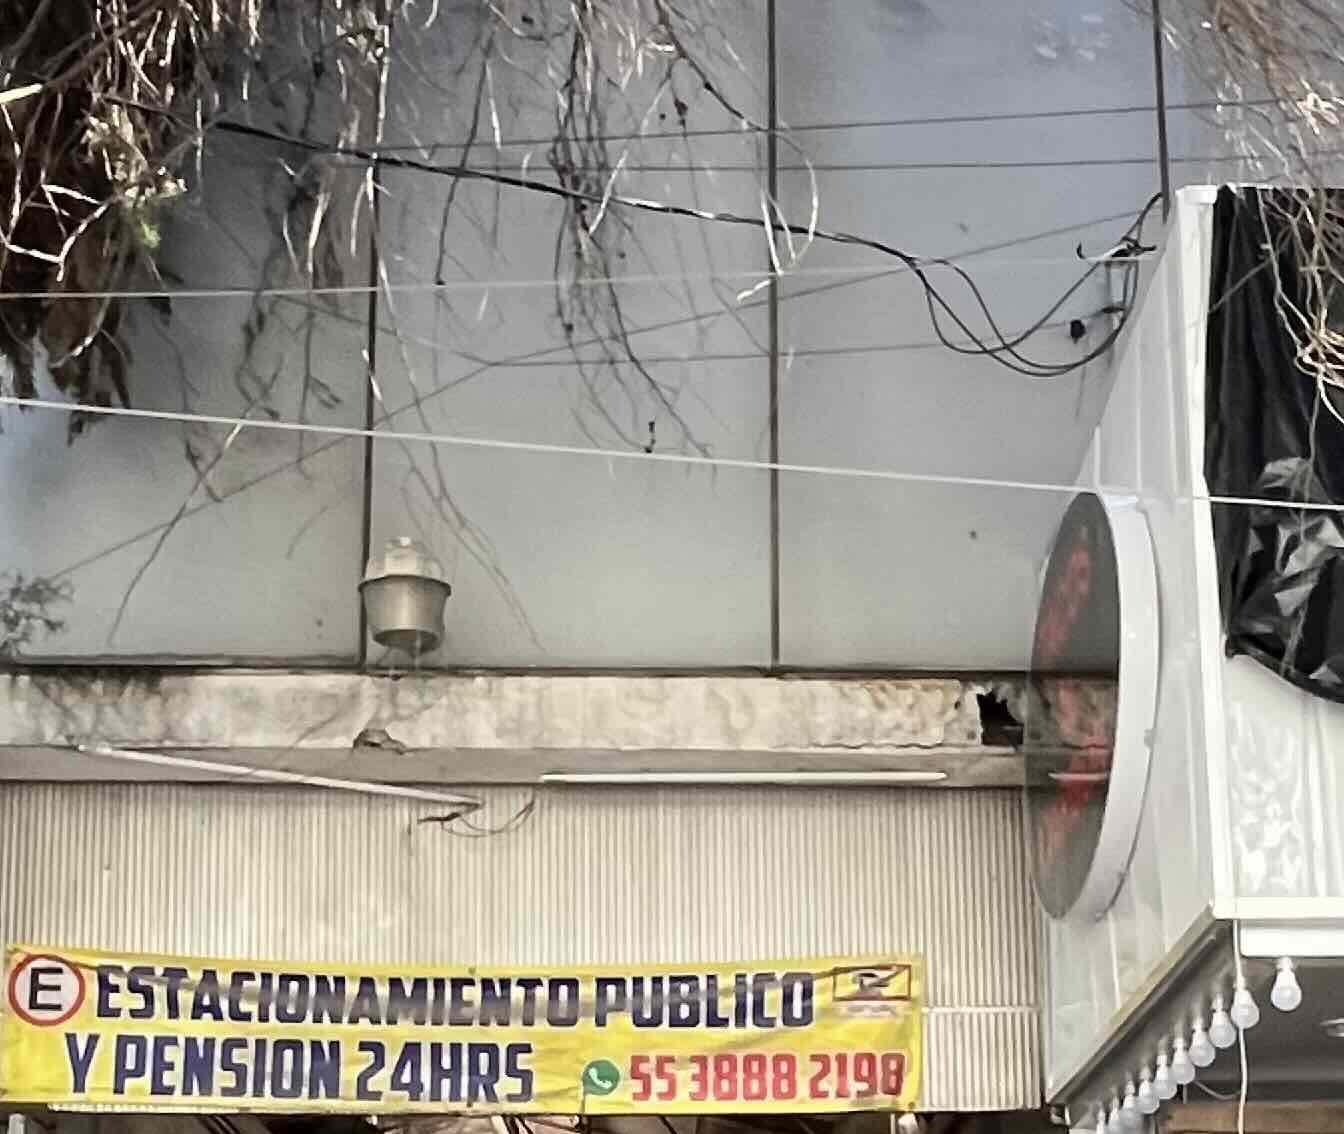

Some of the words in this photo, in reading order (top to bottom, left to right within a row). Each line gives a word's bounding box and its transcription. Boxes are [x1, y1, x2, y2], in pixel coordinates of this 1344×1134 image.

[29, 967, 63, 1011] E
[96, 965, 578, 1027] ESTACIONAMIENTO
[595, 973, 814, 1028] PUBLICO
[65, 1033, 100, 1093] Y
[113, 1034, 346, 1099] PENSION
[356, 1041, 533, 1102] 24HRS
[630, 1056, 677, 1100] 55
[689, 1053, 797, 1100] 3888
[809, 1052, 906, 1099] 2198
